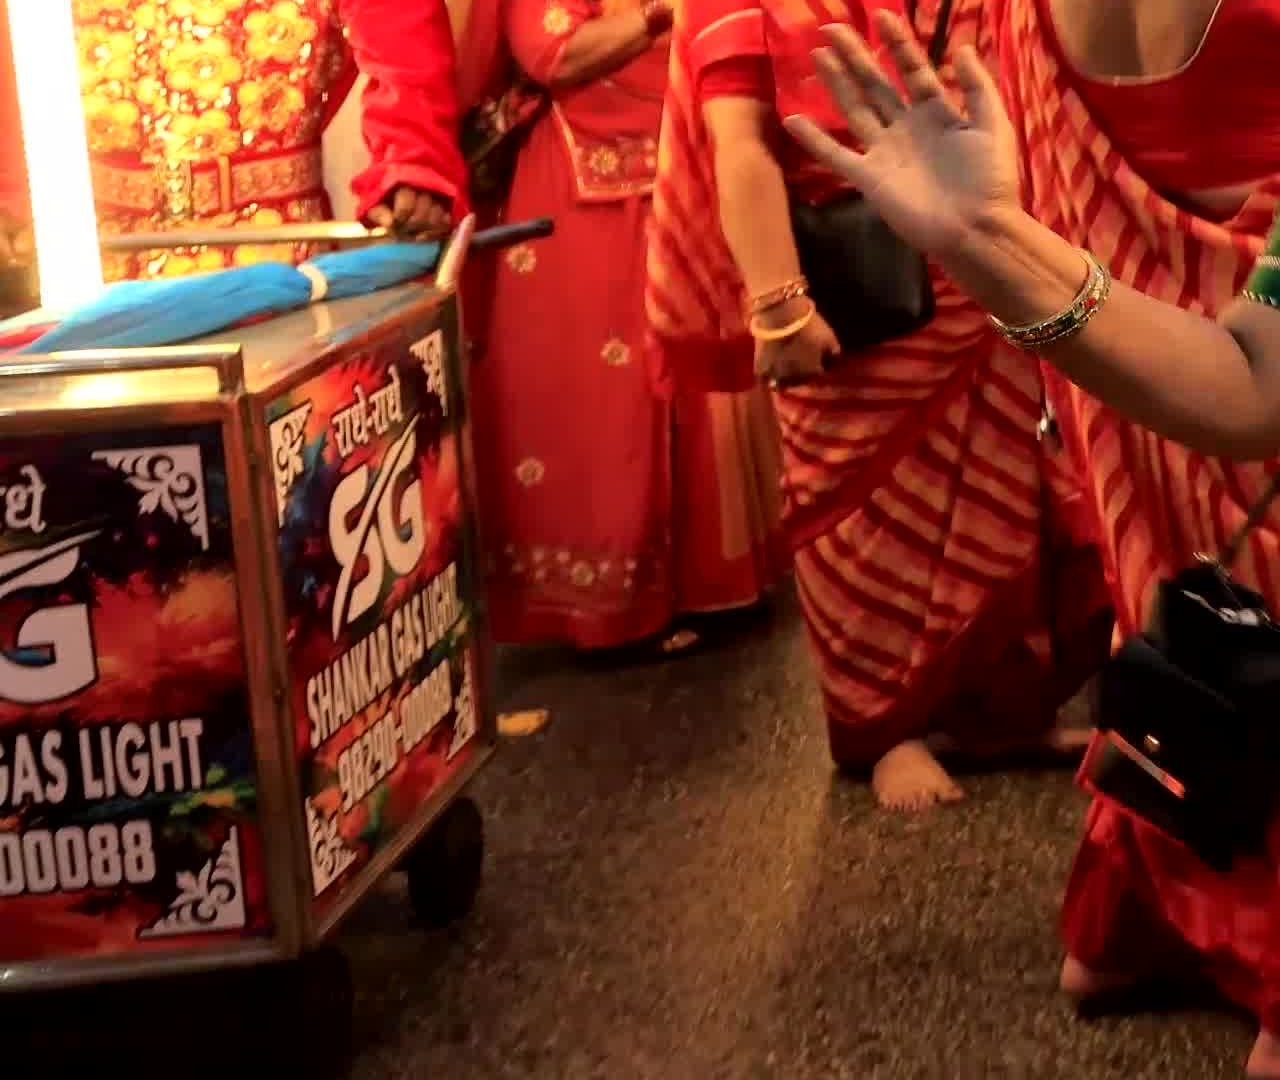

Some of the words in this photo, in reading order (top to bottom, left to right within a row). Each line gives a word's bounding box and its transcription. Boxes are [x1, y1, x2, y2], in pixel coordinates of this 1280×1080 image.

[331, 365, 402, 457] राधे-राधे
[0, 465, 46, 531] धे
[307, 622, 393, 750] SHANKAR
[391, 593, 424, 677] GAS
[422, 561, 460, 650] LIGHT
[0, 729, 69, 808] AS
[79, 718, 203, 800] LIGHT
